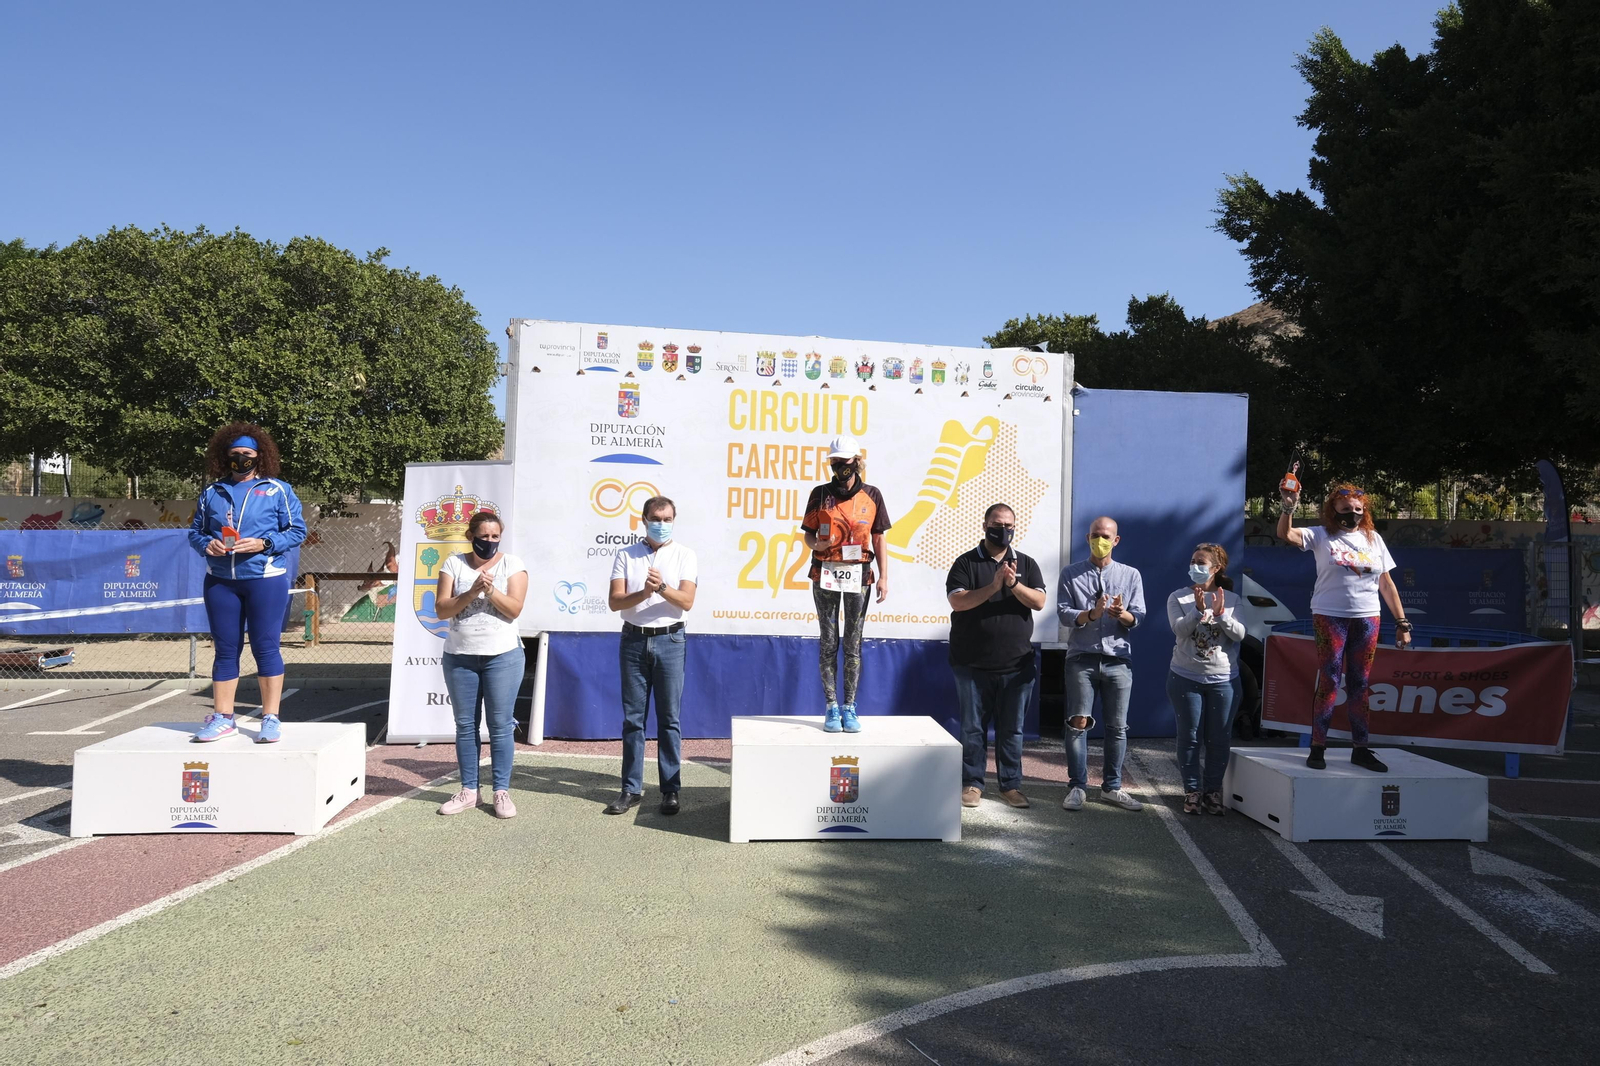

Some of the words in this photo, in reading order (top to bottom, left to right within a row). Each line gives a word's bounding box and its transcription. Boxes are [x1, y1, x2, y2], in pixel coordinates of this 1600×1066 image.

[583, 351, 621, 359] DIPUTACIÓN
[1015, 383, 1044, 392] circuitos
[729, 389, 868, 436] CIRCUITO
[590, 423, 666, 436] DIPUTACIÓN
[591, 436, 607, 446] DE
[610, 436, 663, 448] ALMERÍA
[727, 443, 867, 482] CARRER
[727, 487, 808, 520] POPUL
[587, 546, 620, 558] provi
[737, 526, 812, 598] 202
[832, 570, 852, 580] 120
[0, 581, 46, 590] PUTACIÓN
[103, 581, 159, 590] DIPUTACIÓN
[5, 590, 43, 598] ALMERÍA
[119, 590, 157, 598] ALMERÍA
[1392, 670, 1441, 681] SPORT
[1443, 671, 1454, 681] &
[1458, 671, 1510, 682] SHOES
[1314, 669, 1509, 717] anes
[169, 805, 219, 813] DIPUTACIÓN
[816, 805, 869, 814] DIPUTACIÓN
[184, 813, 218, 821] ALMERÍA
[817, 815, 829, 823] DE
[830, 814, 867, 823] ALMERÍA
